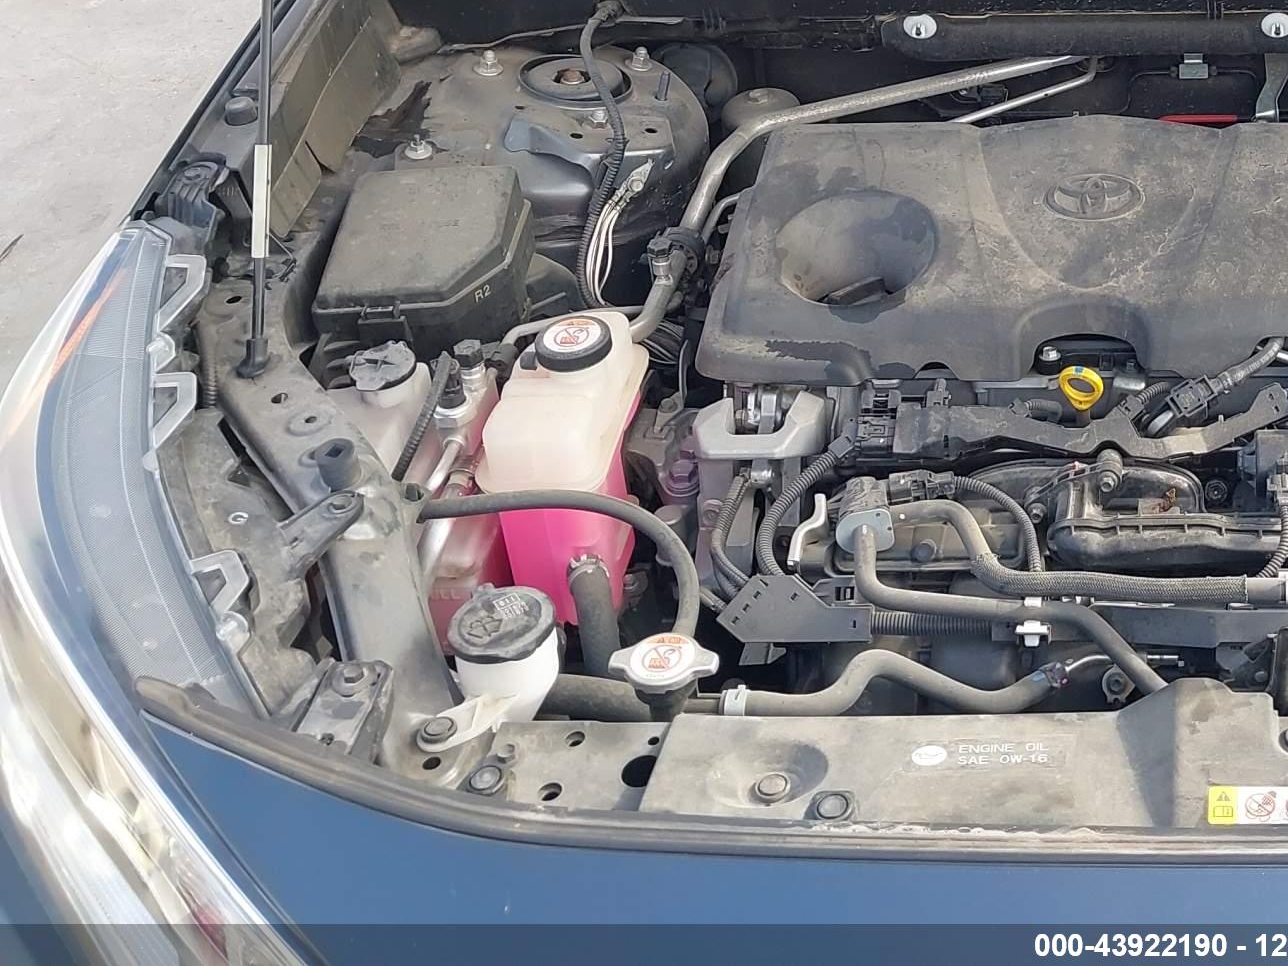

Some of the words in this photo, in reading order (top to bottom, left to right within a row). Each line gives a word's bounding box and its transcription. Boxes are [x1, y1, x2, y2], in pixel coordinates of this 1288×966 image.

[474, 284, 492, 304] R2
[227, 511, 249, 526] G
[958, 743, 1016, 754] ENGINE
[1025, 742, 1049, 752] OIL
[957, 755, 990, 765] SAE
